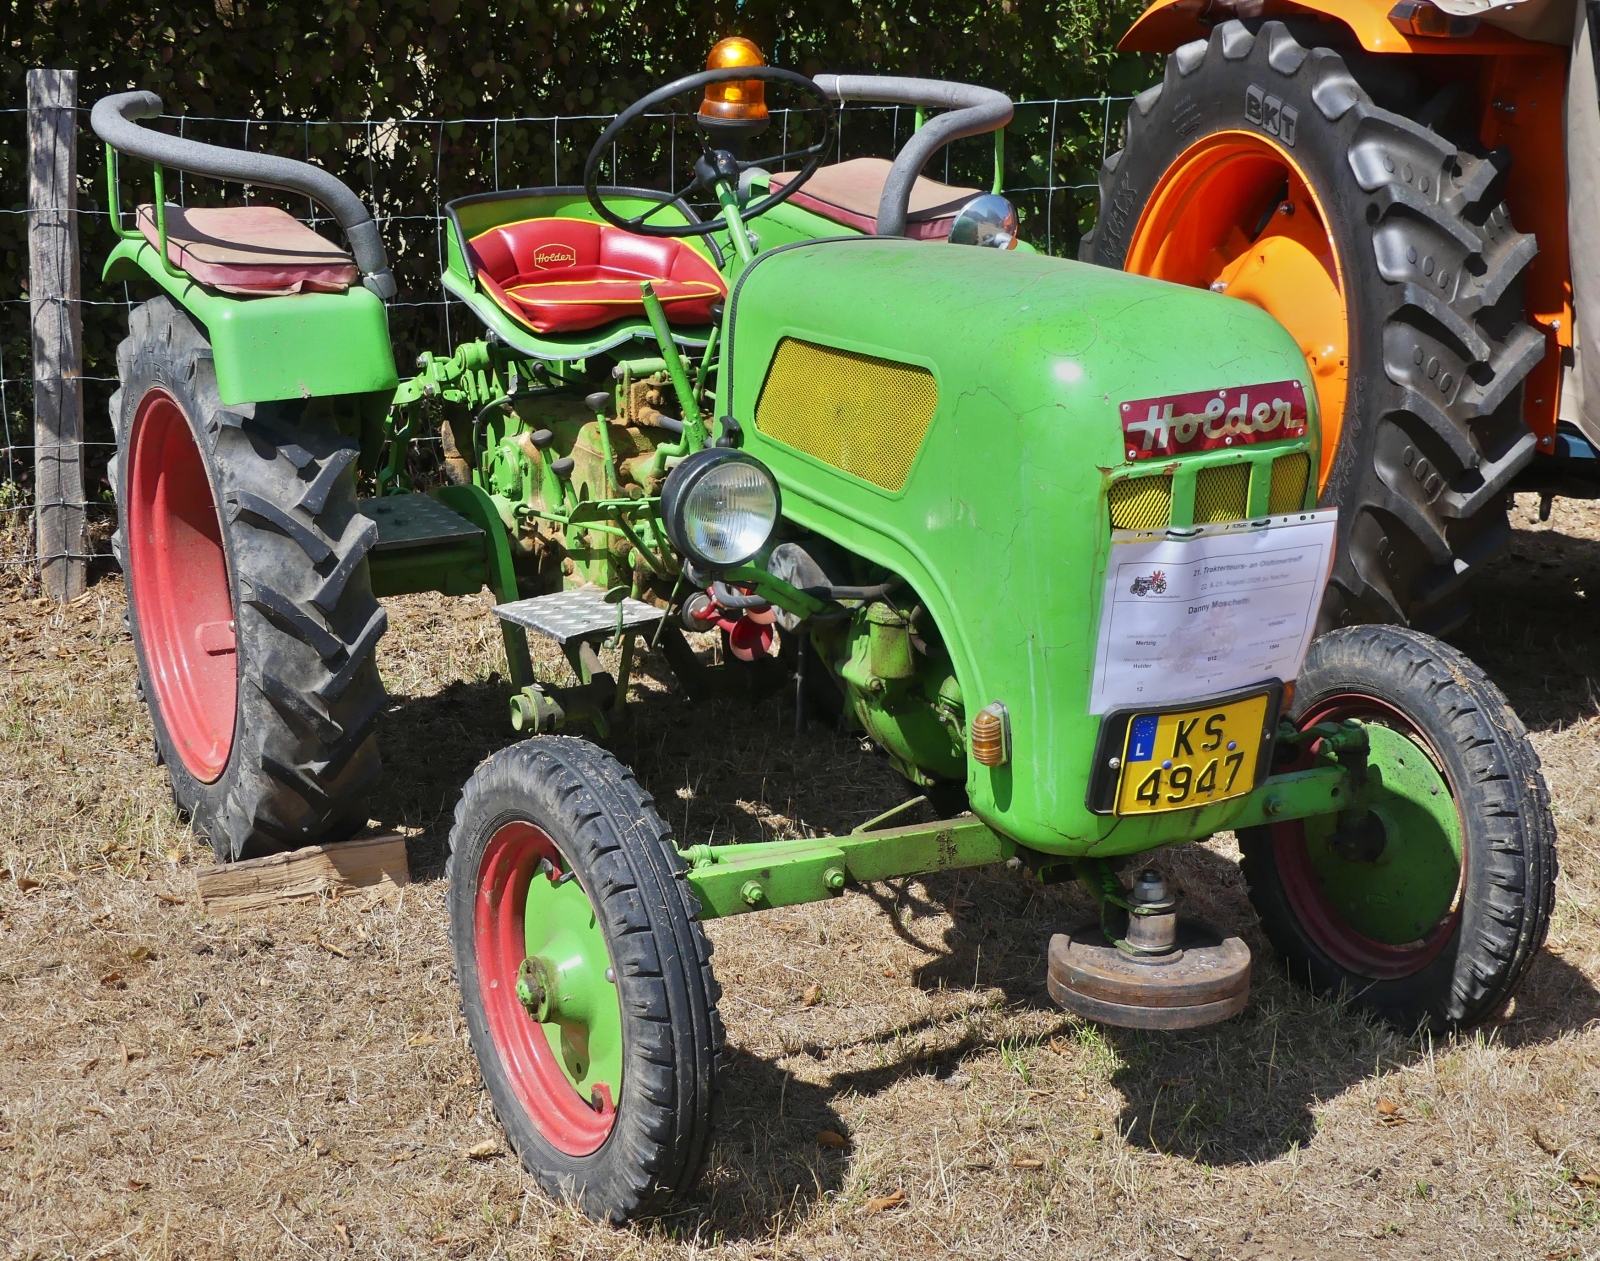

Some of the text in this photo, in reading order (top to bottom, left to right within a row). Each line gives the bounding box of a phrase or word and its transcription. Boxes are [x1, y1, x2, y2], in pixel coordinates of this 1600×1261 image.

[1245, 85, 1299, 147] BKT
[535, 252, 575, 263] Holder
[1127, 394, 1304, 450] Holder
[1188, 603, 1210, 615] Danny
[1135, 743, 1145, 757] L
[1172, 713, 1226, 759] KS
[1135, 751, 1244, 806] 4947
